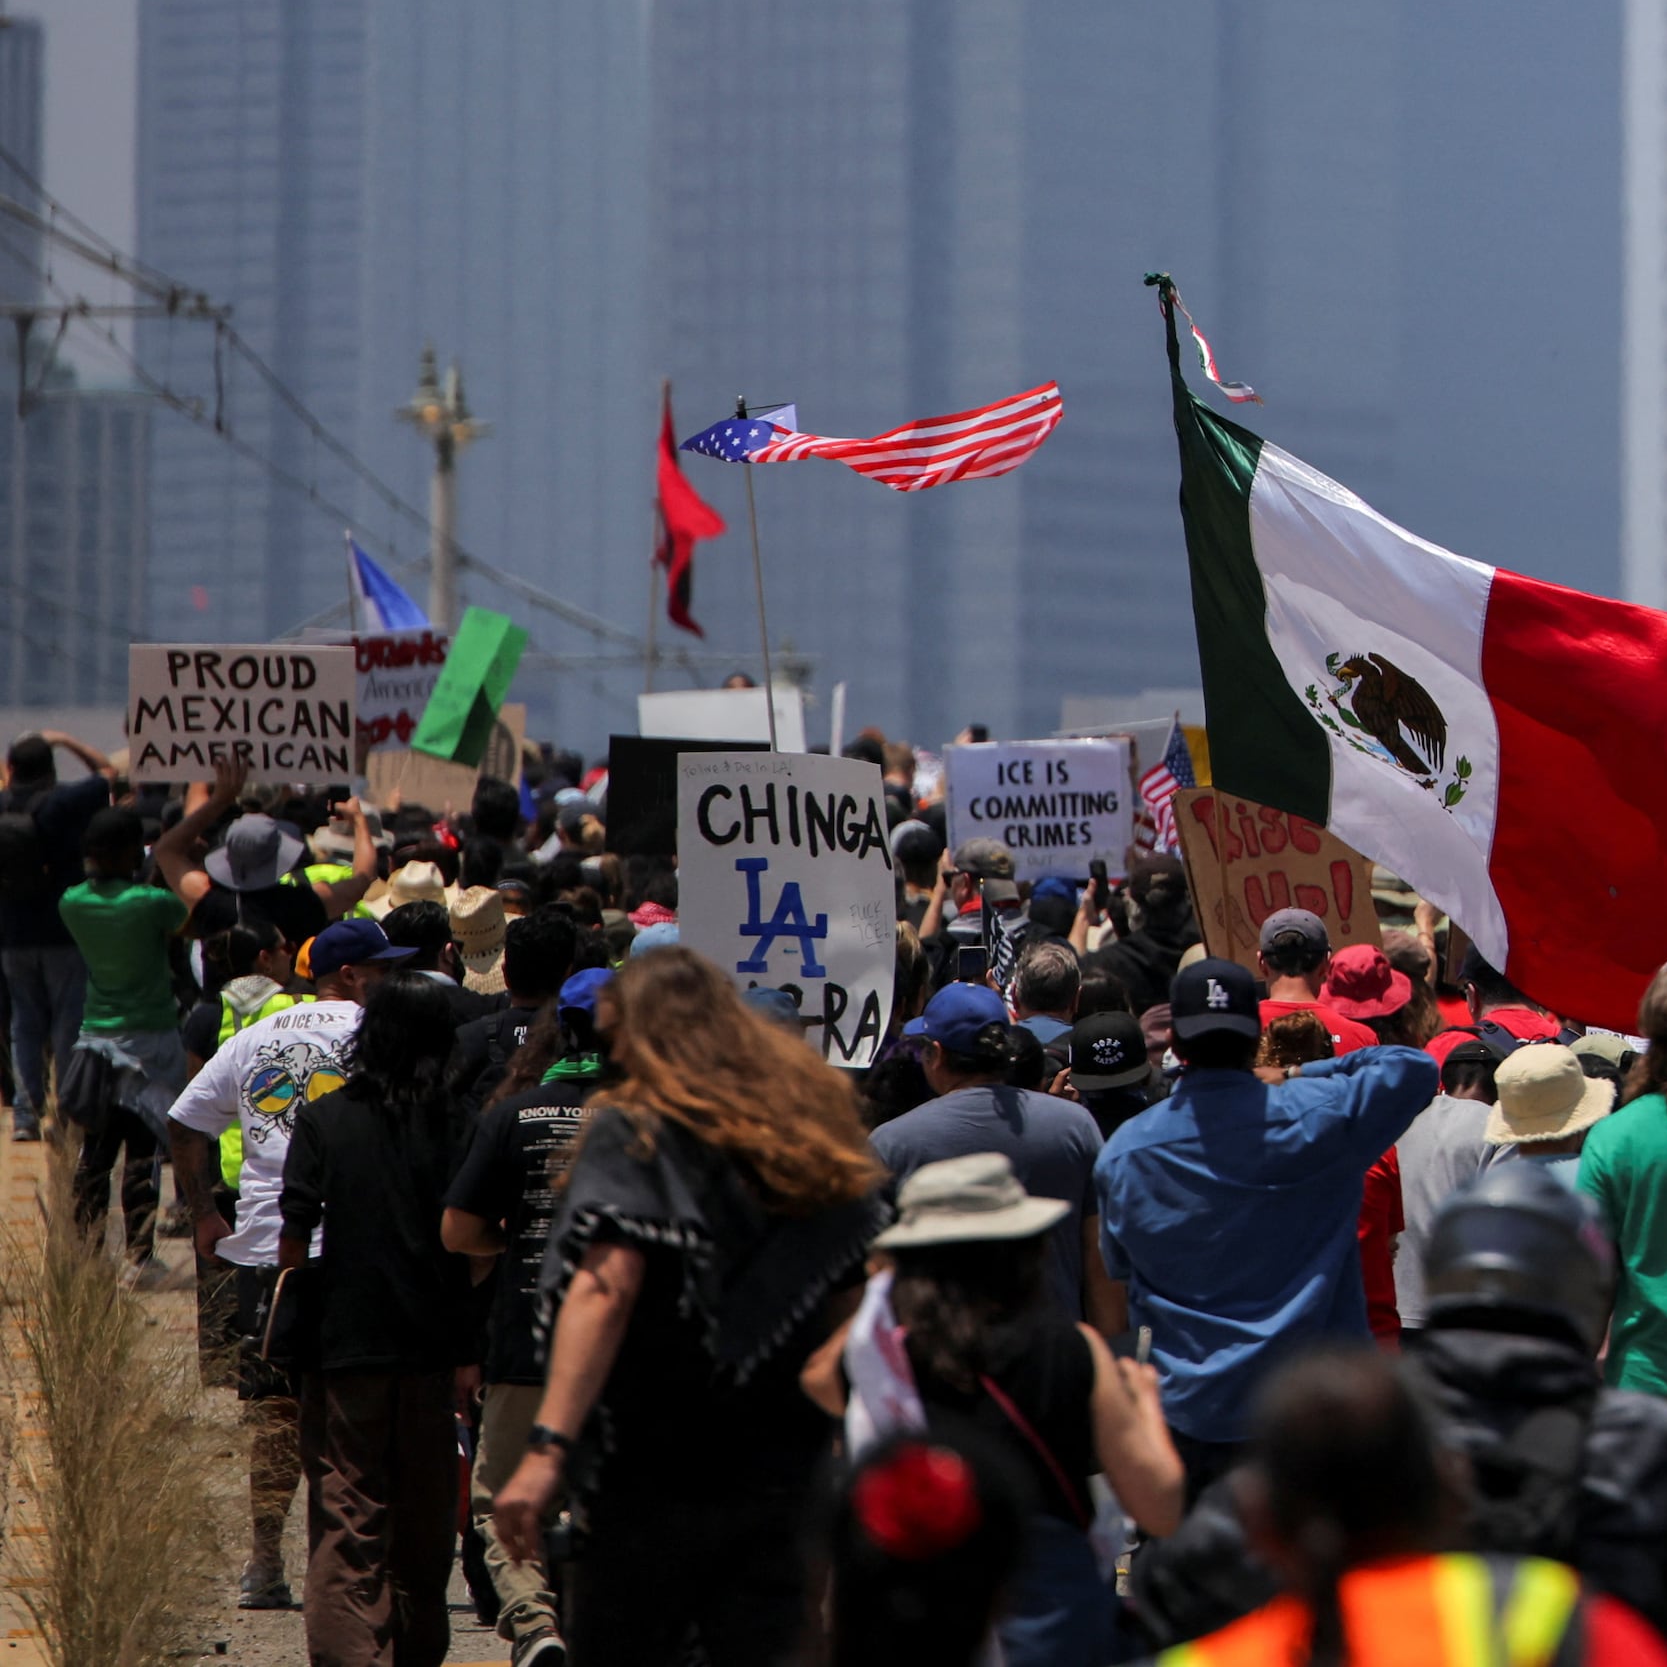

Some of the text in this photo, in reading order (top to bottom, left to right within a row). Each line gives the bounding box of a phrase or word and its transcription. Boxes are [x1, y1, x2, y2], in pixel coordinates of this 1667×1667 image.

[167, 650, 317, 691] PROUD
[134, 695, 350, 738] MEXICAN
[138, 739, 349, 772] AMERICAN
[998, 759, 1069, 784] ICE IS
[969, 791, 1119, 821] COMMITTING
[697, 783, 893, 870] CHINGA
[1004, 822, 1092, 848] CRIMES
[735, 857, 828, 978] LA
[1207, 978, 1229, 1009] LA
[273, 1013, 312, 1030] NO ICE
[518, 1106, 561, 1120] KNOW
